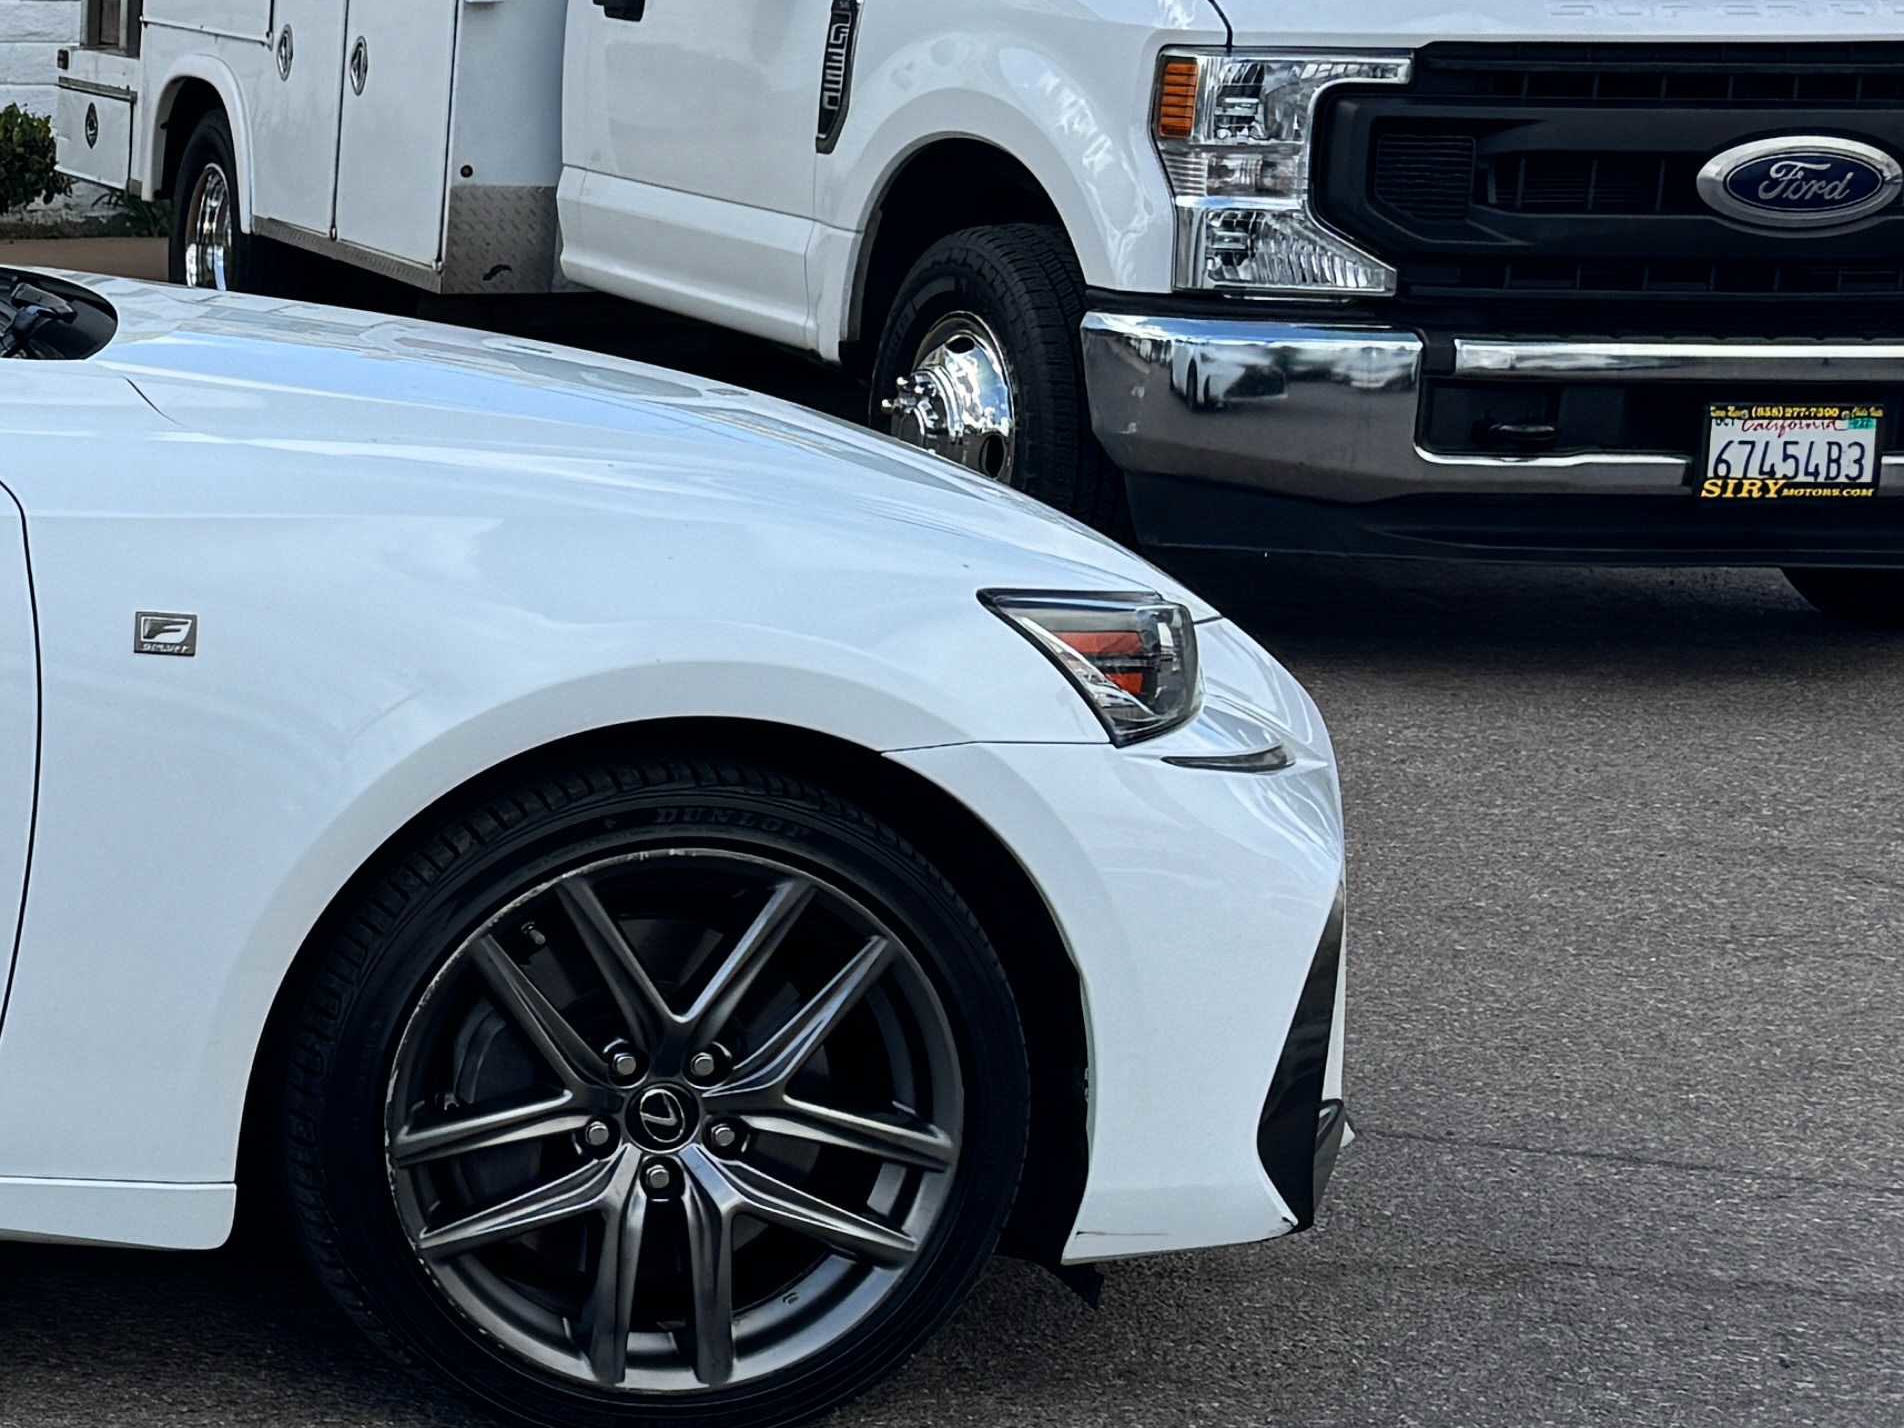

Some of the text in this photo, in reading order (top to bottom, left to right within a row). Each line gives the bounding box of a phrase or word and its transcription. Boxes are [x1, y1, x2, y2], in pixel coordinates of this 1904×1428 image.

[1759, 161, 1854, 201] Ford
[1741, 419, 1849, 438] California
[1713, 440, 1866, 482] 67454B3
[1701, 479, 1874, 498] SIRY MOTORS.COM
